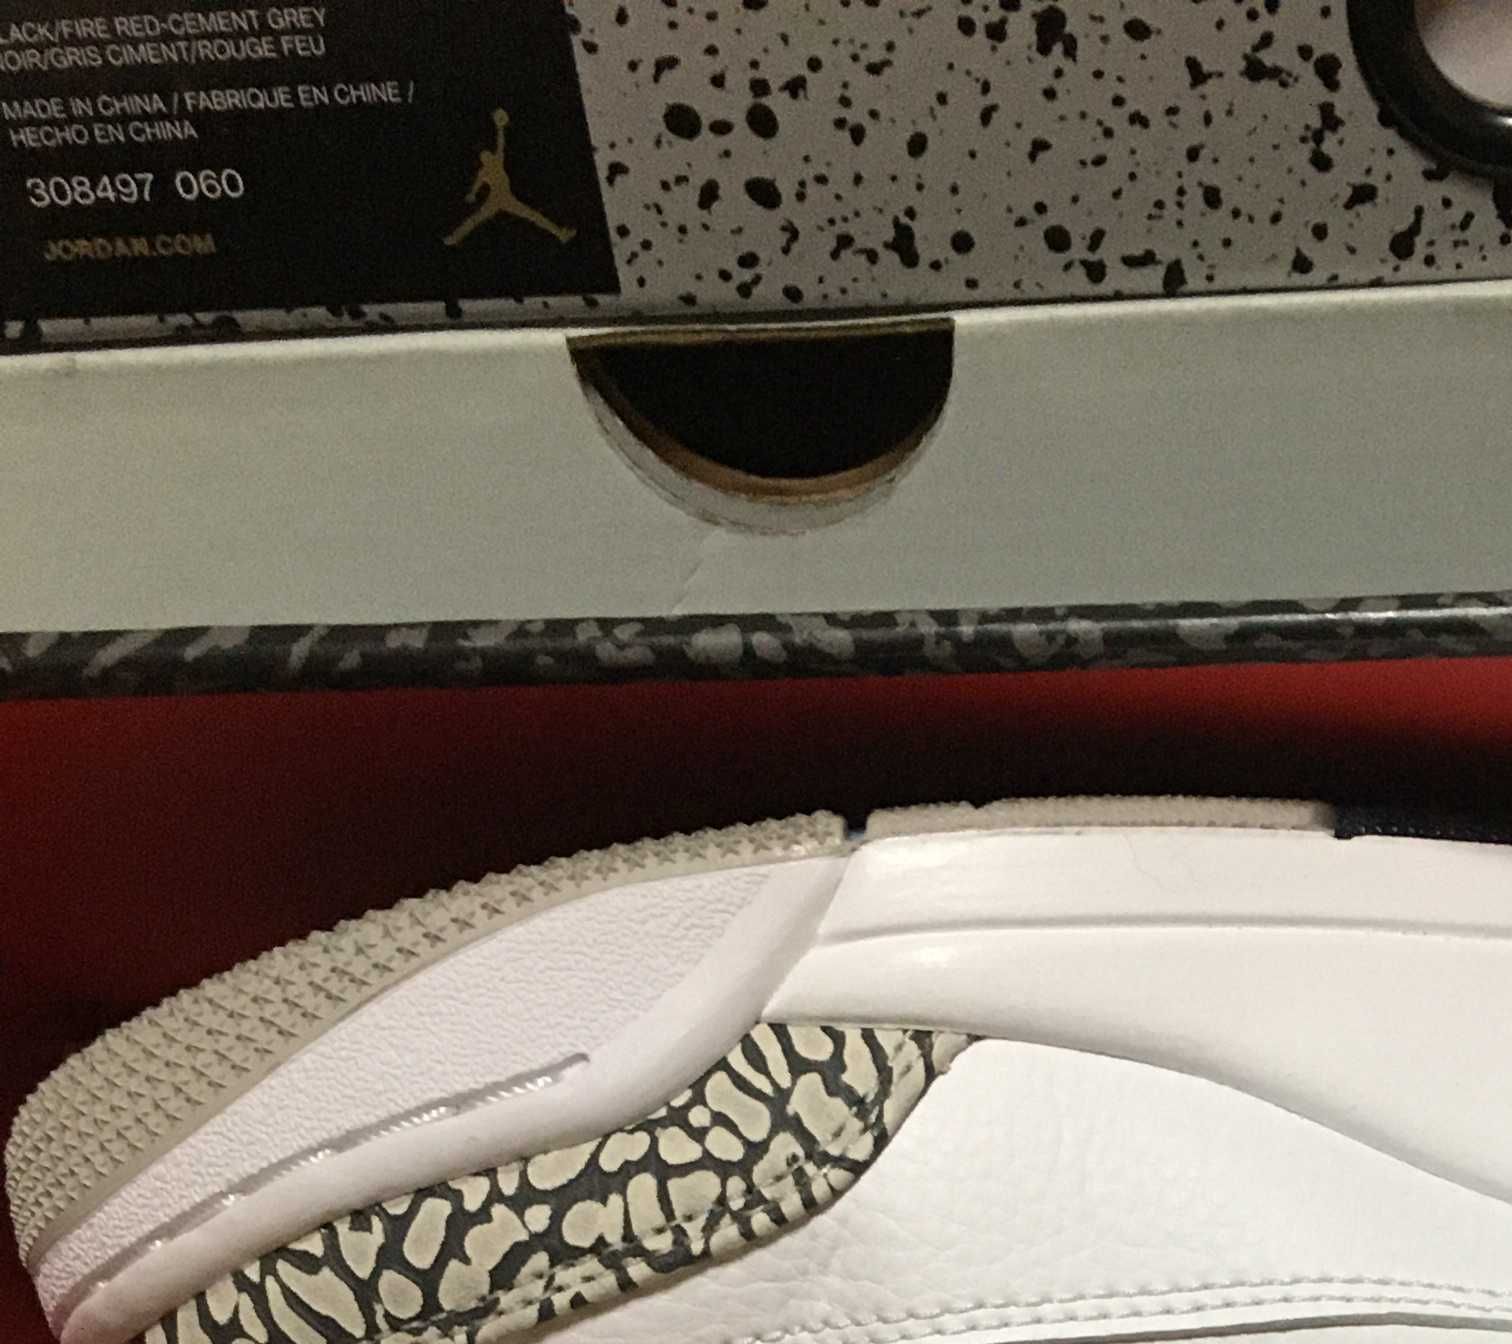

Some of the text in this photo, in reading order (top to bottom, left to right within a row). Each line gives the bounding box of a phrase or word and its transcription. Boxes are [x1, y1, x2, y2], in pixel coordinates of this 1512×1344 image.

[0, 7, 326, 44] ACK/FIRE RED-CEMENT GREY
[105, 36, 277, 66] CIMENT/ROUGE
[281, 34, 326, 57] FEU
[2, 79, 415, 121] MADE IN CHINA / FABRIQUE EN CHINE /
[9, 119, 199, 148] HECHO EN CHINA
[26, 168, 244, 208] 308497 060
[44, 233, 217, 261] JORDAN.COM
